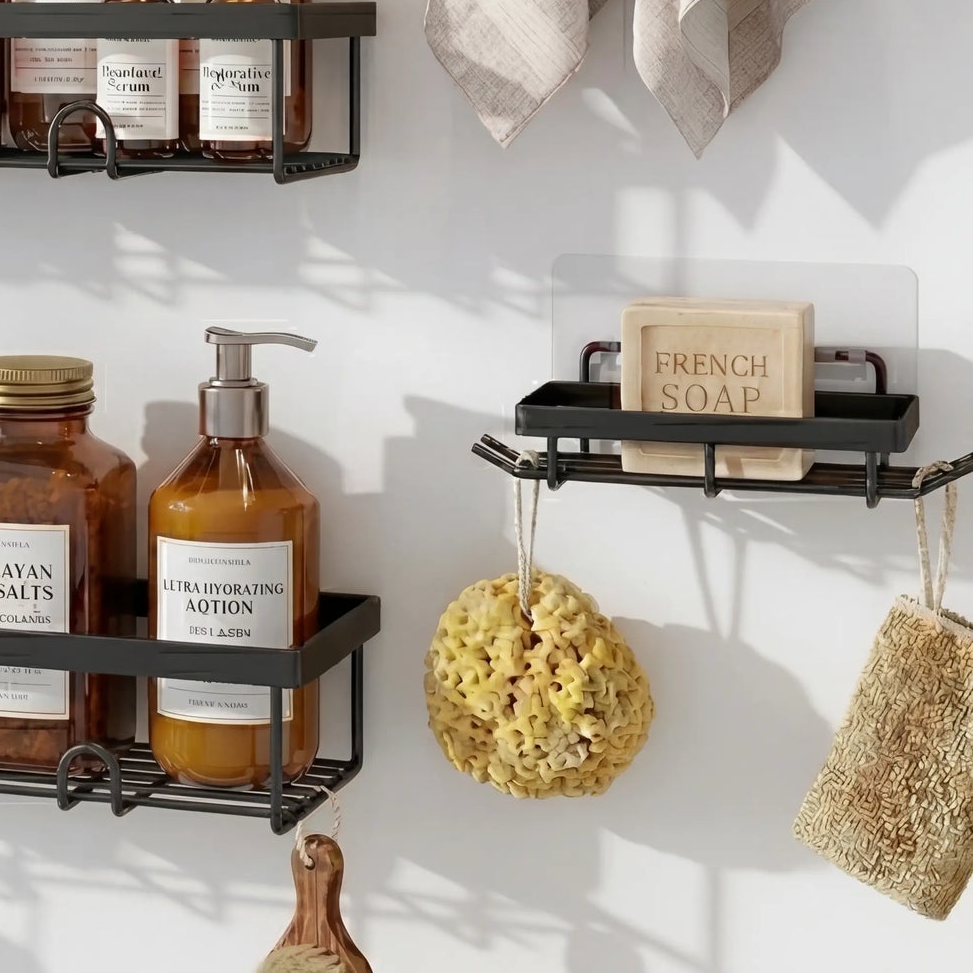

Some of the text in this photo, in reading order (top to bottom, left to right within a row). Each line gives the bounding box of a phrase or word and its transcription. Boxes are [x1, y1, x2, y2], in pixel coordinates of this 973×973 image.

[655, 351, 769, 378] FRENCH
[661, 383, 761, 414] SOAP
[186, 599, 254, 615] AQTION
